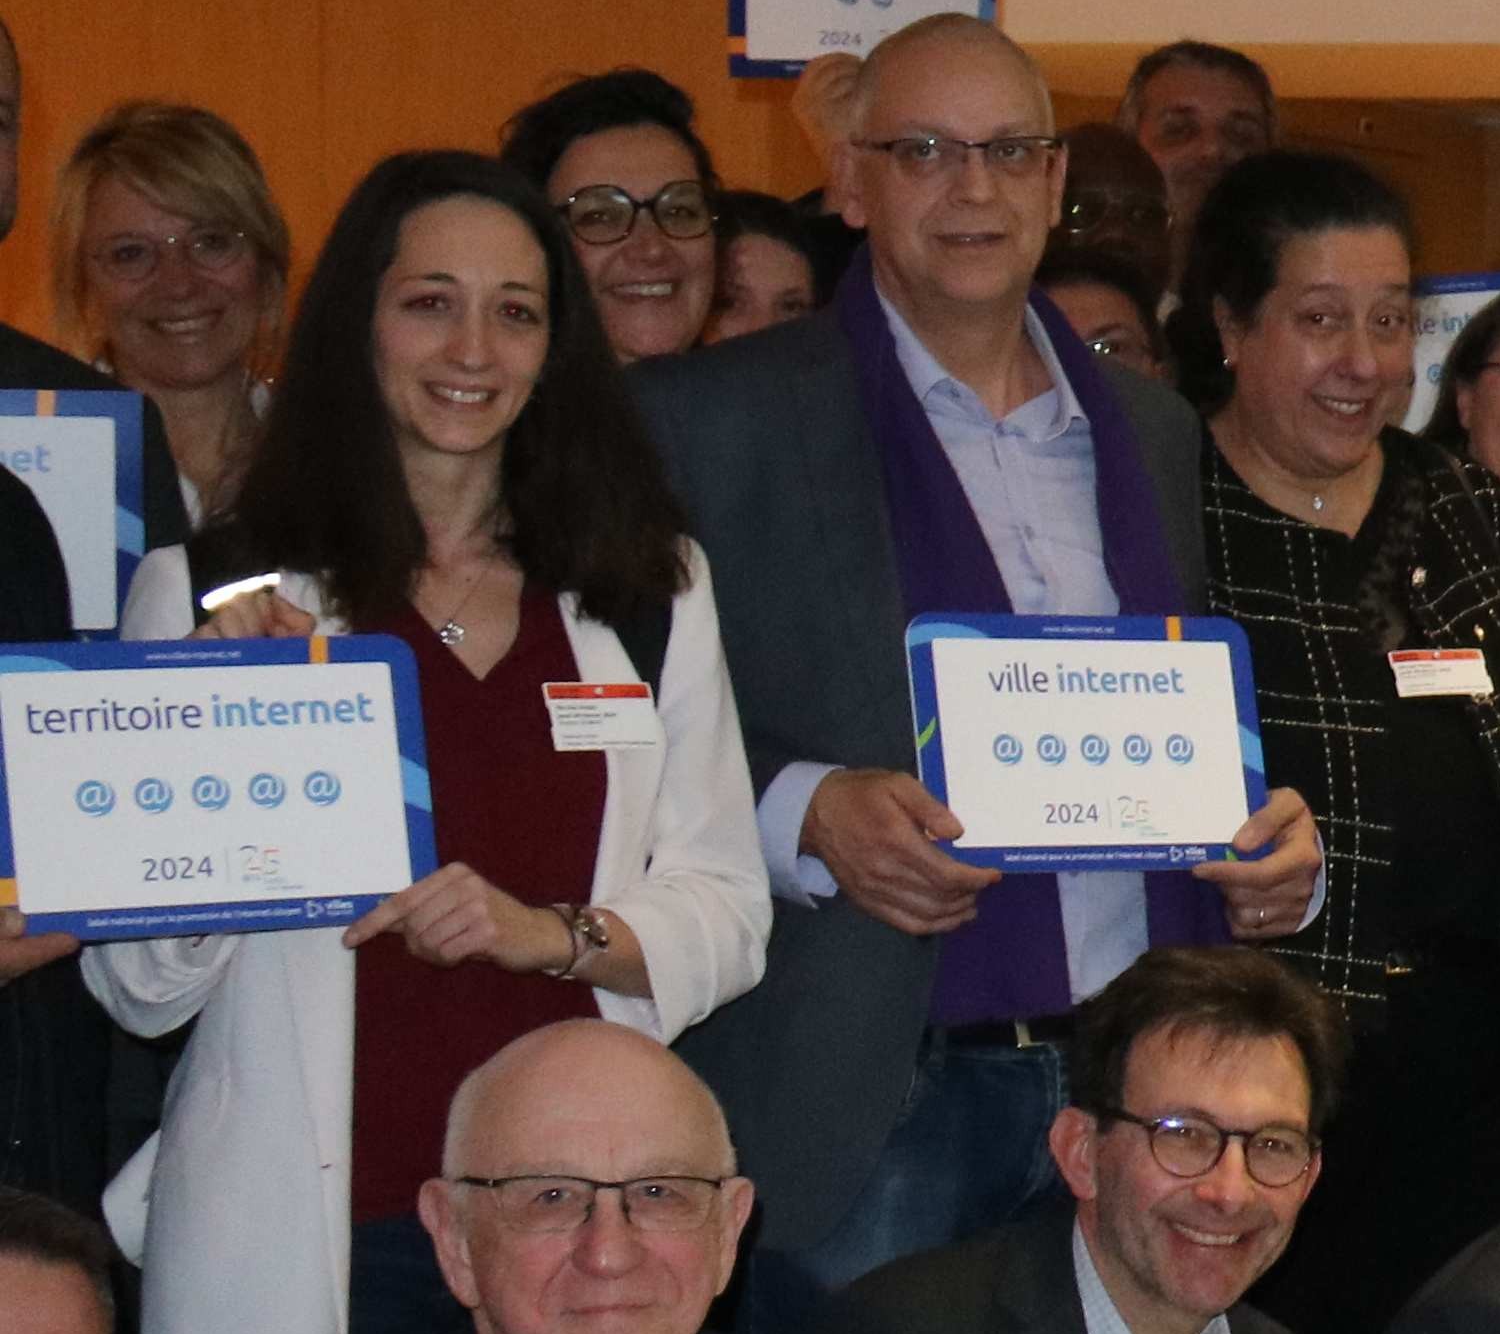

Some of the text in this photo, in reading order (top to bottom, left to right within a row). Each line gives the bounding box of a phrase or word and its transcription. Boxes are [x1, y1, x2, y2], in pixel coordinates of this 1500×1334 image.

[819, 29, 862, 45] 2024
[987, 661, 1185, 695] ville internet
[24, 691, 376, 736] territoire internet
[1044, 802, 1100, 825] 2024
[141, 855, 215, 883] 2024
